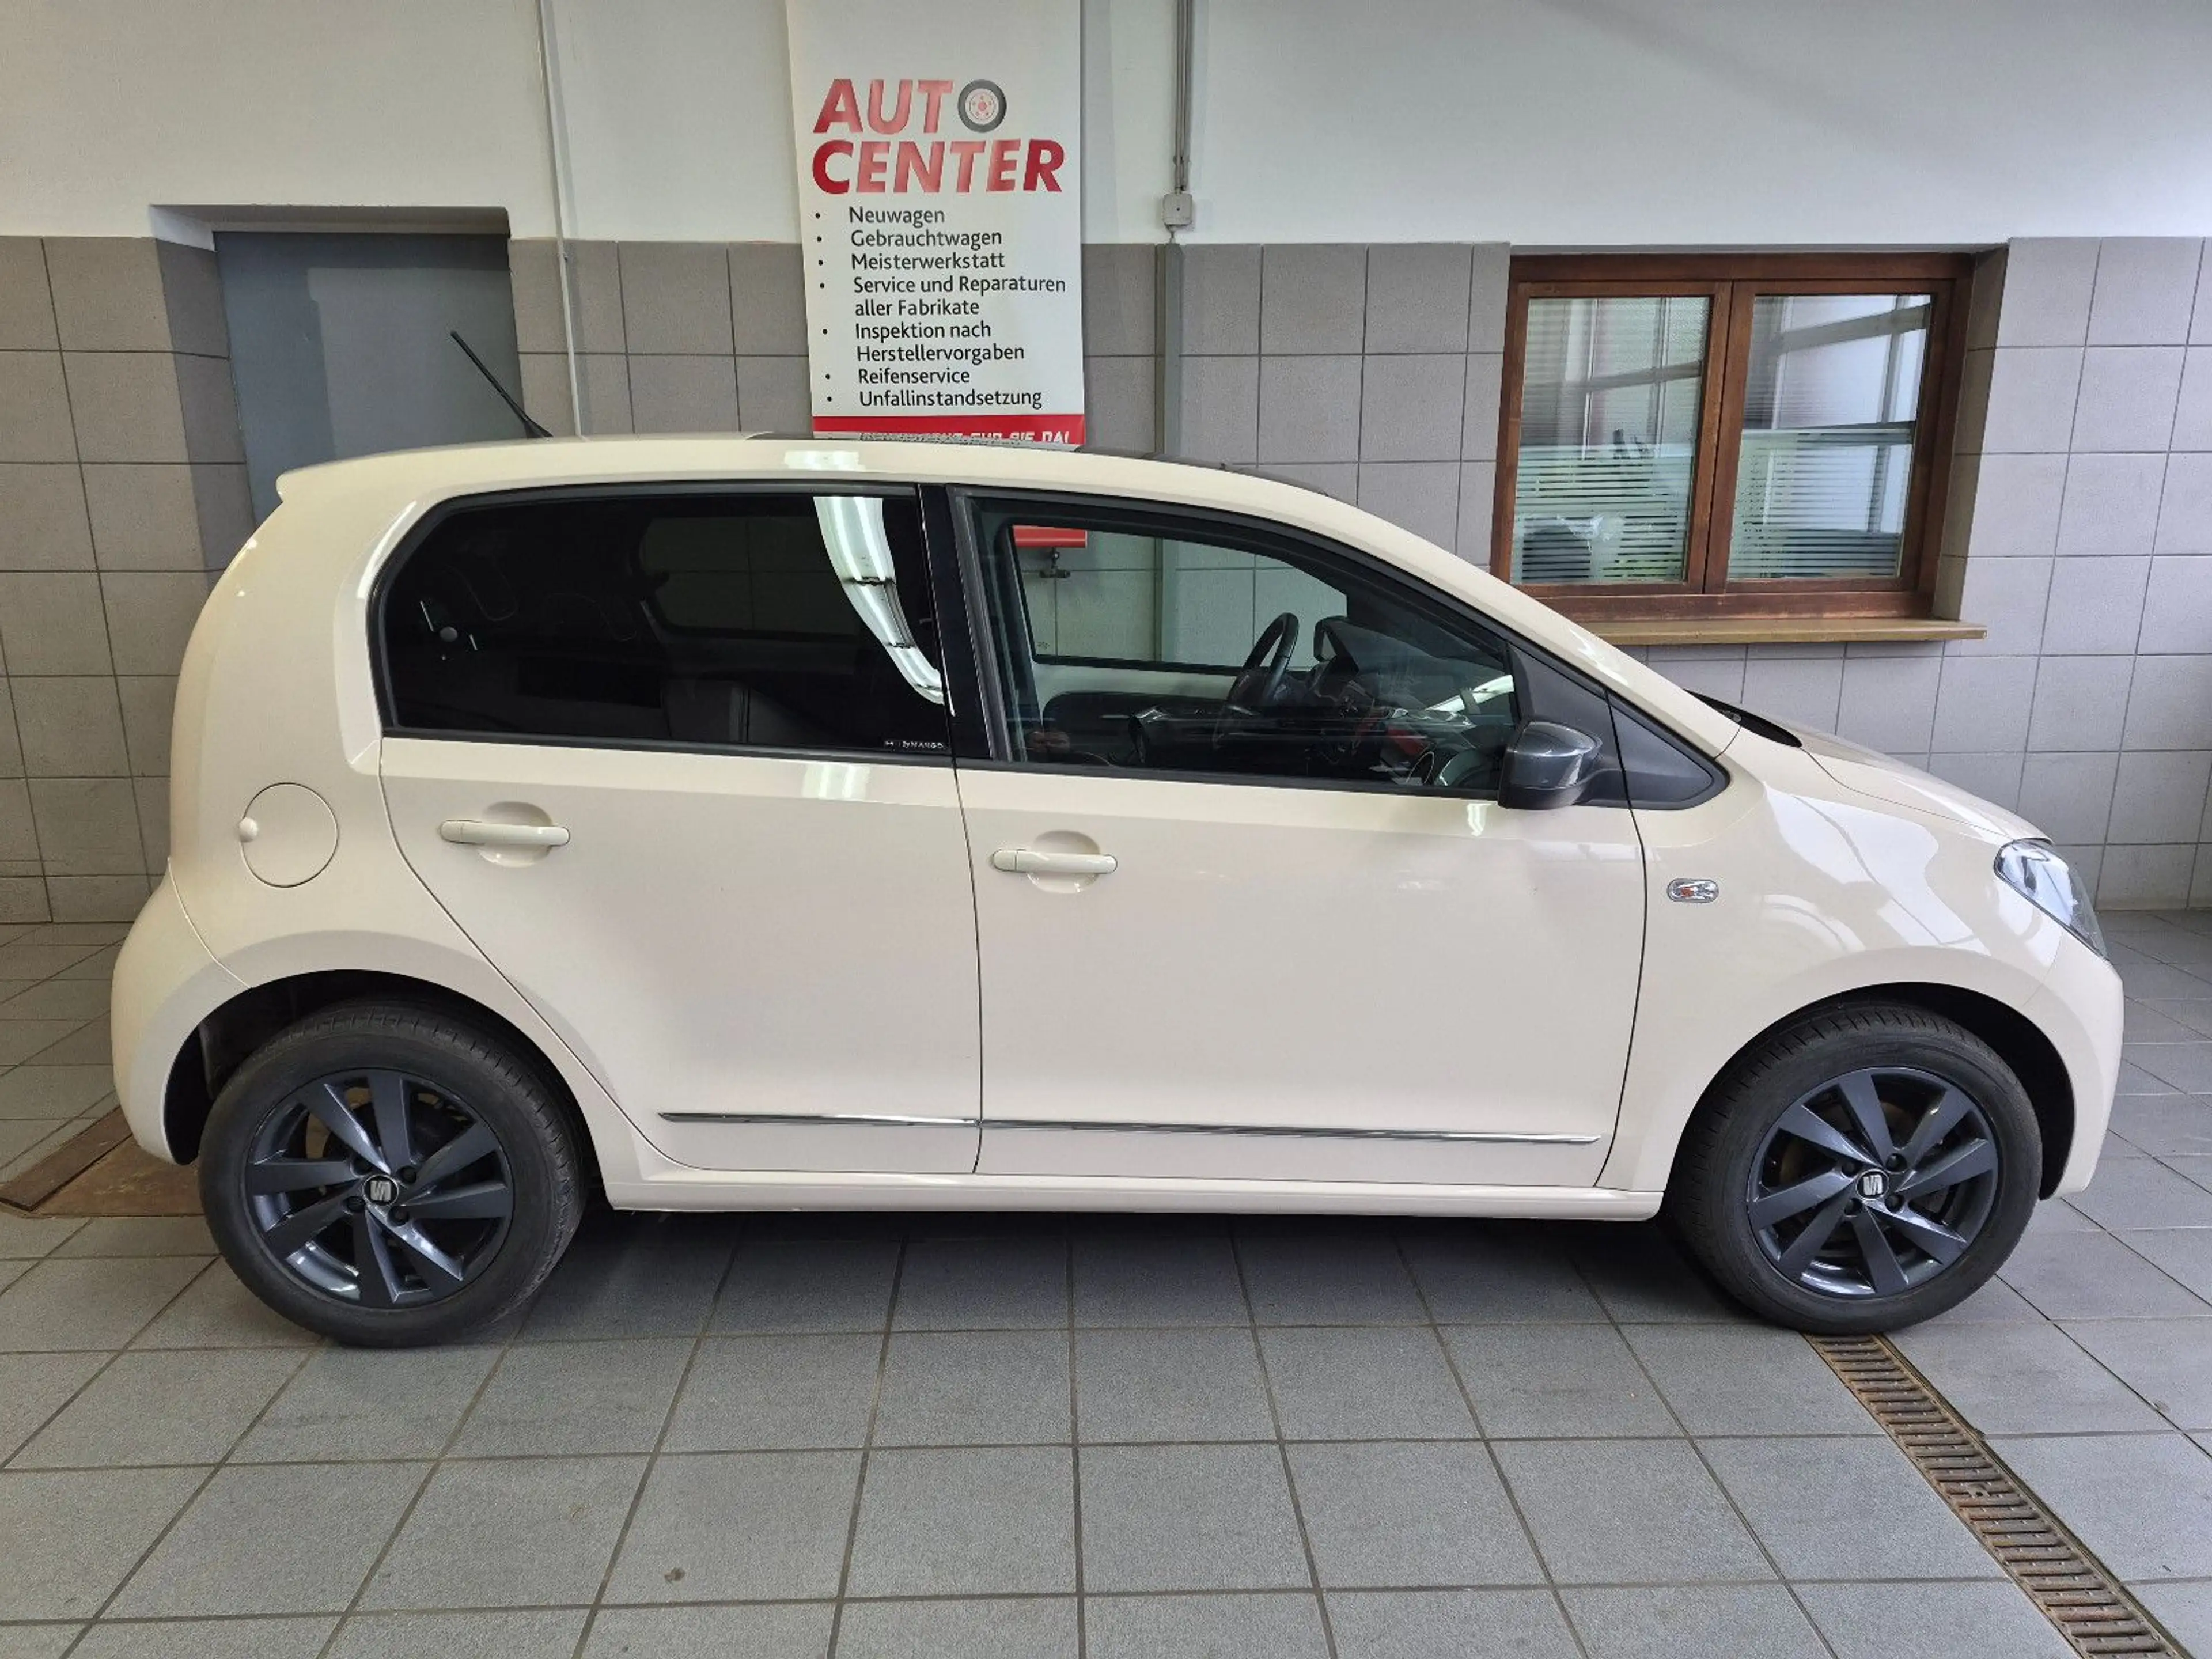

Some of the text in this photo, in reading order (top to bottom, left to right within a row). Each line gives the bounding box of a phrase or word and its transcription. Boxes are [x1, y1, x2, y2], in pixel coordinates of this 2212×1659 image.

[812, 139, 1065, 194] CENTER
[849, 206, 945, 228] Neuwagen
[851, 229, 1002, 251] Gebrauchtwagen
[851, 251, 1005, 270] Meisterwerkstatt
[854, 275, 1066, 296] Service und Reparaturen
[855, 298, 980, 316] aller Fabrikate
[855, 320, 991, 347] Inspektion nach
[857, 343, 1025, 366] Herstellervorgaben
[859, 368, 971, 384] Reifenservice
[859, 389, 1043, 410] Unfallinstandsetzung
